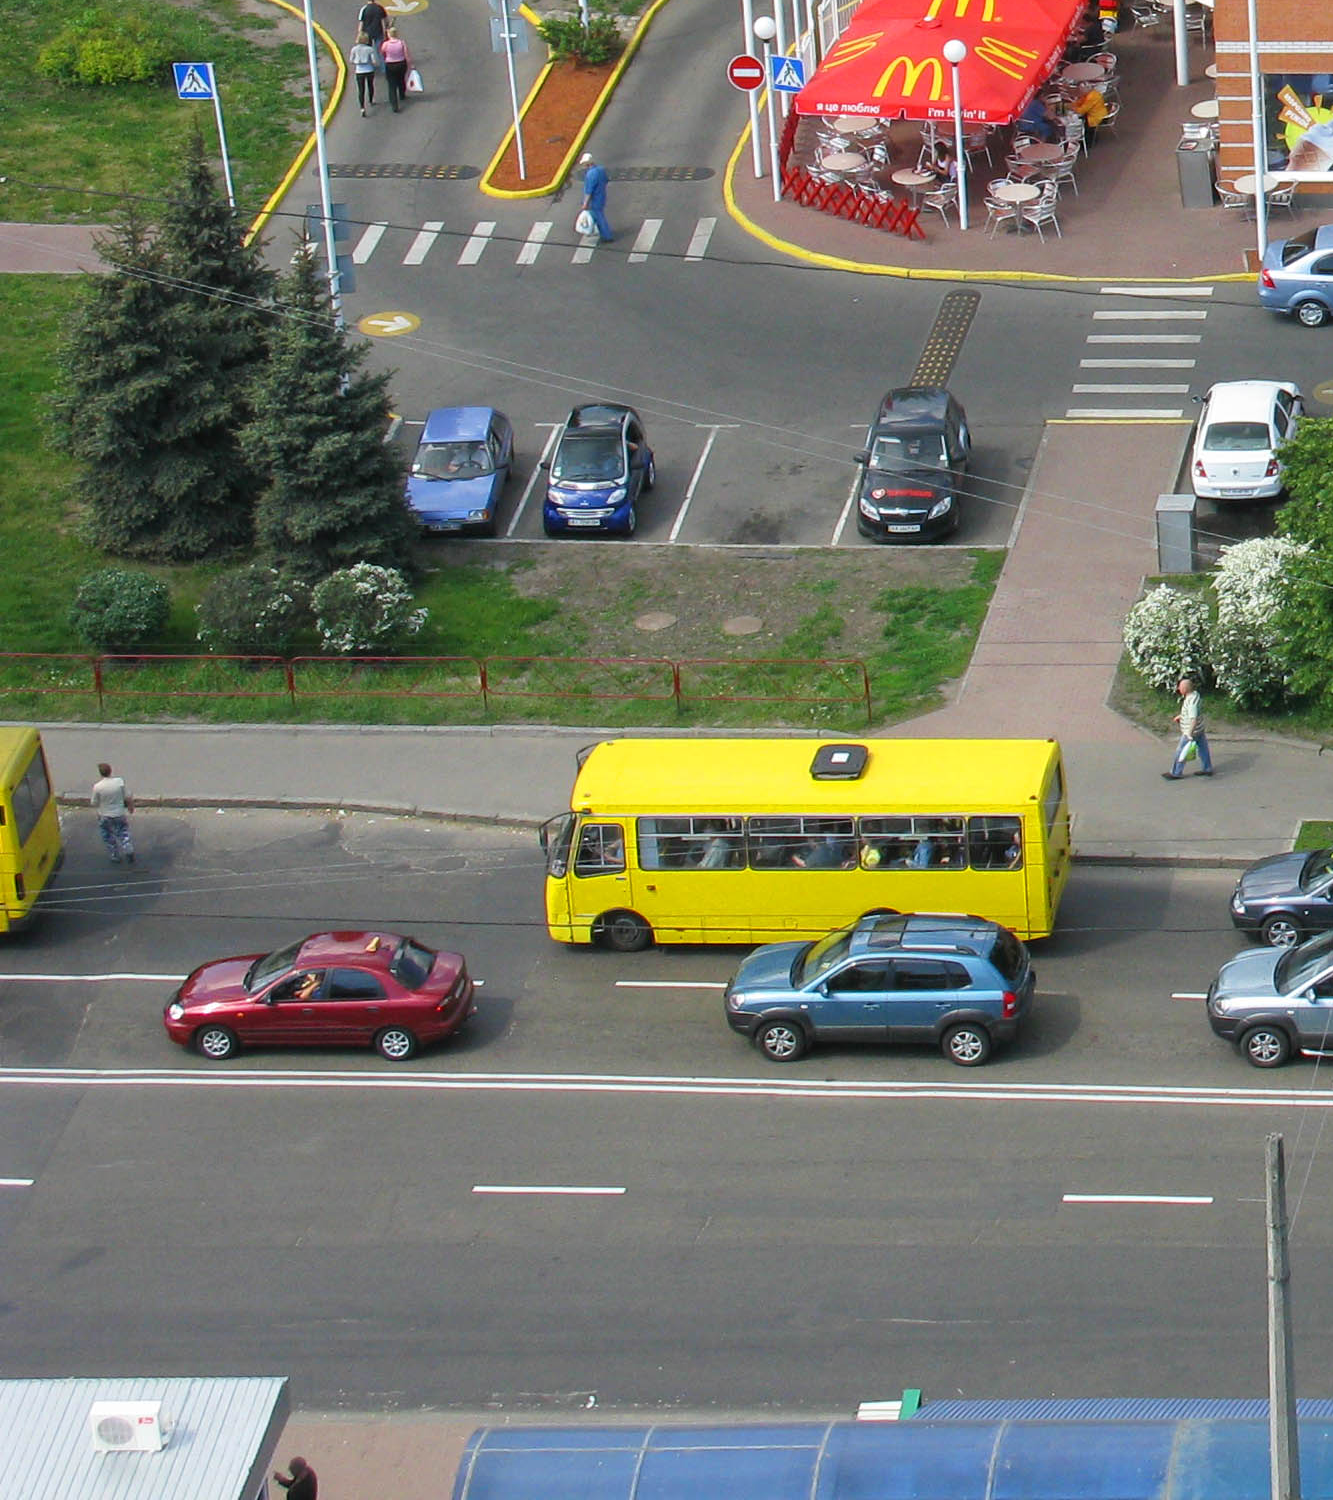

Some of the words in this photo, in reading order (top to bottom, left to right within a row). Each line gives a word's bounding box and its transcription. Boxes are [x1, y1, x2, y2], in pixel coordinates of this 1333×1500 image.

[816, 102, 824, 111] я
[825, 103, 839, 113] це
[840, 102, 880, 114] люблю
[928, 107, 945, 117] i'm
[947, 108, 977, 119] loin'
[978, 110, 986, 119] it
